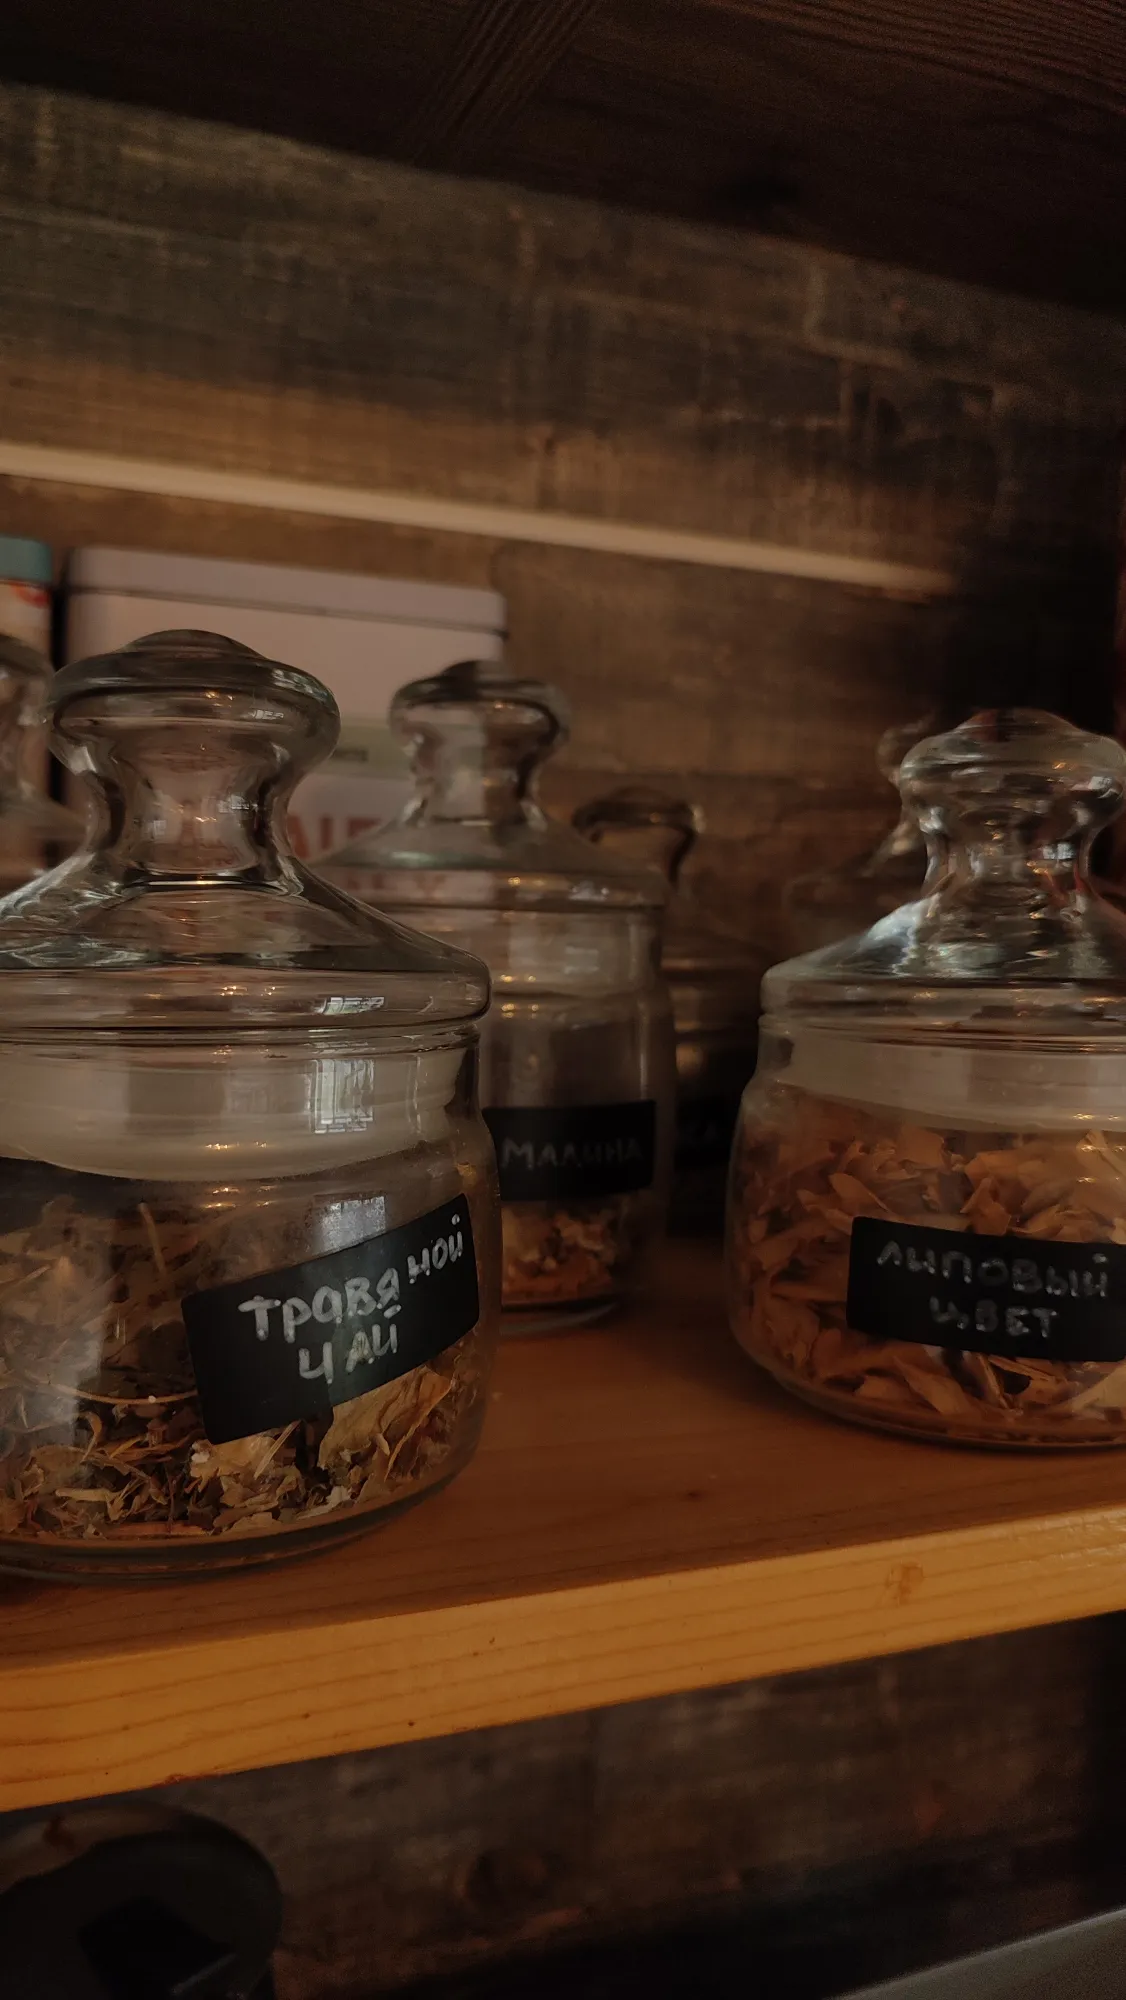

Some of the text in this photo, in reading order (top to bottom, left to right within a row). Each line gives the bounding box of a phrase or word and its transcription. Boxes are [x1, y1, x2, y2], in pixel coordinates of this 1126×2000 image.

[501, 1136, 644, 1171] МАЛИНА
[876, 1240, 1109, 1298] ЛИПОВЫЙ
[929, 1296, 1058, 1339] ЦВЕТ
[298, 1303, 402, 1385] ЧАЙ
